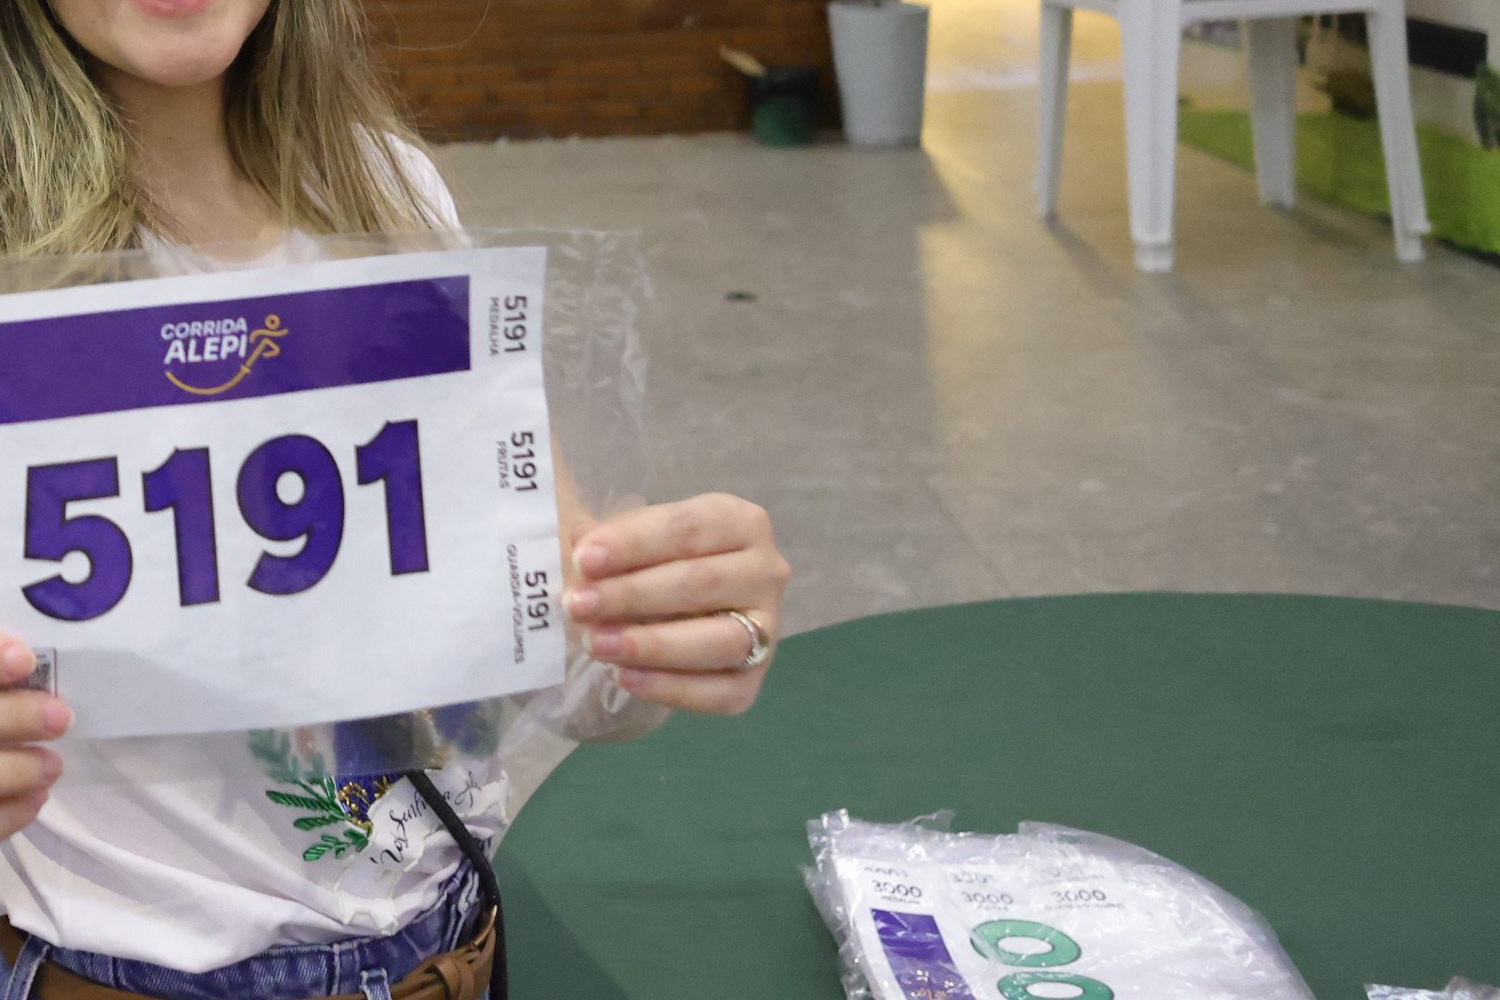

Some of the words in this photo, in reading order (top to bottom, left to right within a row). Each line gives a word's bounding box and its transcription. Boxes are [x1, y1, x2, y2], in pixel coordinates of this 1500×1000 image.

[160, 317, 248, 340] CORRIDA
[163, 333, 248, 365] ALEPI
[489, 296, 500, 358] MEDALHA
[503, 295, 528, 353] 5191
[496, 440, 510, 490] FRUTAS
[511, 431, 539, 493] 5191
[21, 418, 430, 622] 5191
[525, 571, 550, 632] 5191
[871, 879, 923, 899] 3000
[960, 891, 1014, 906] 3000
[1051, 889, 1107, 903] 3000
